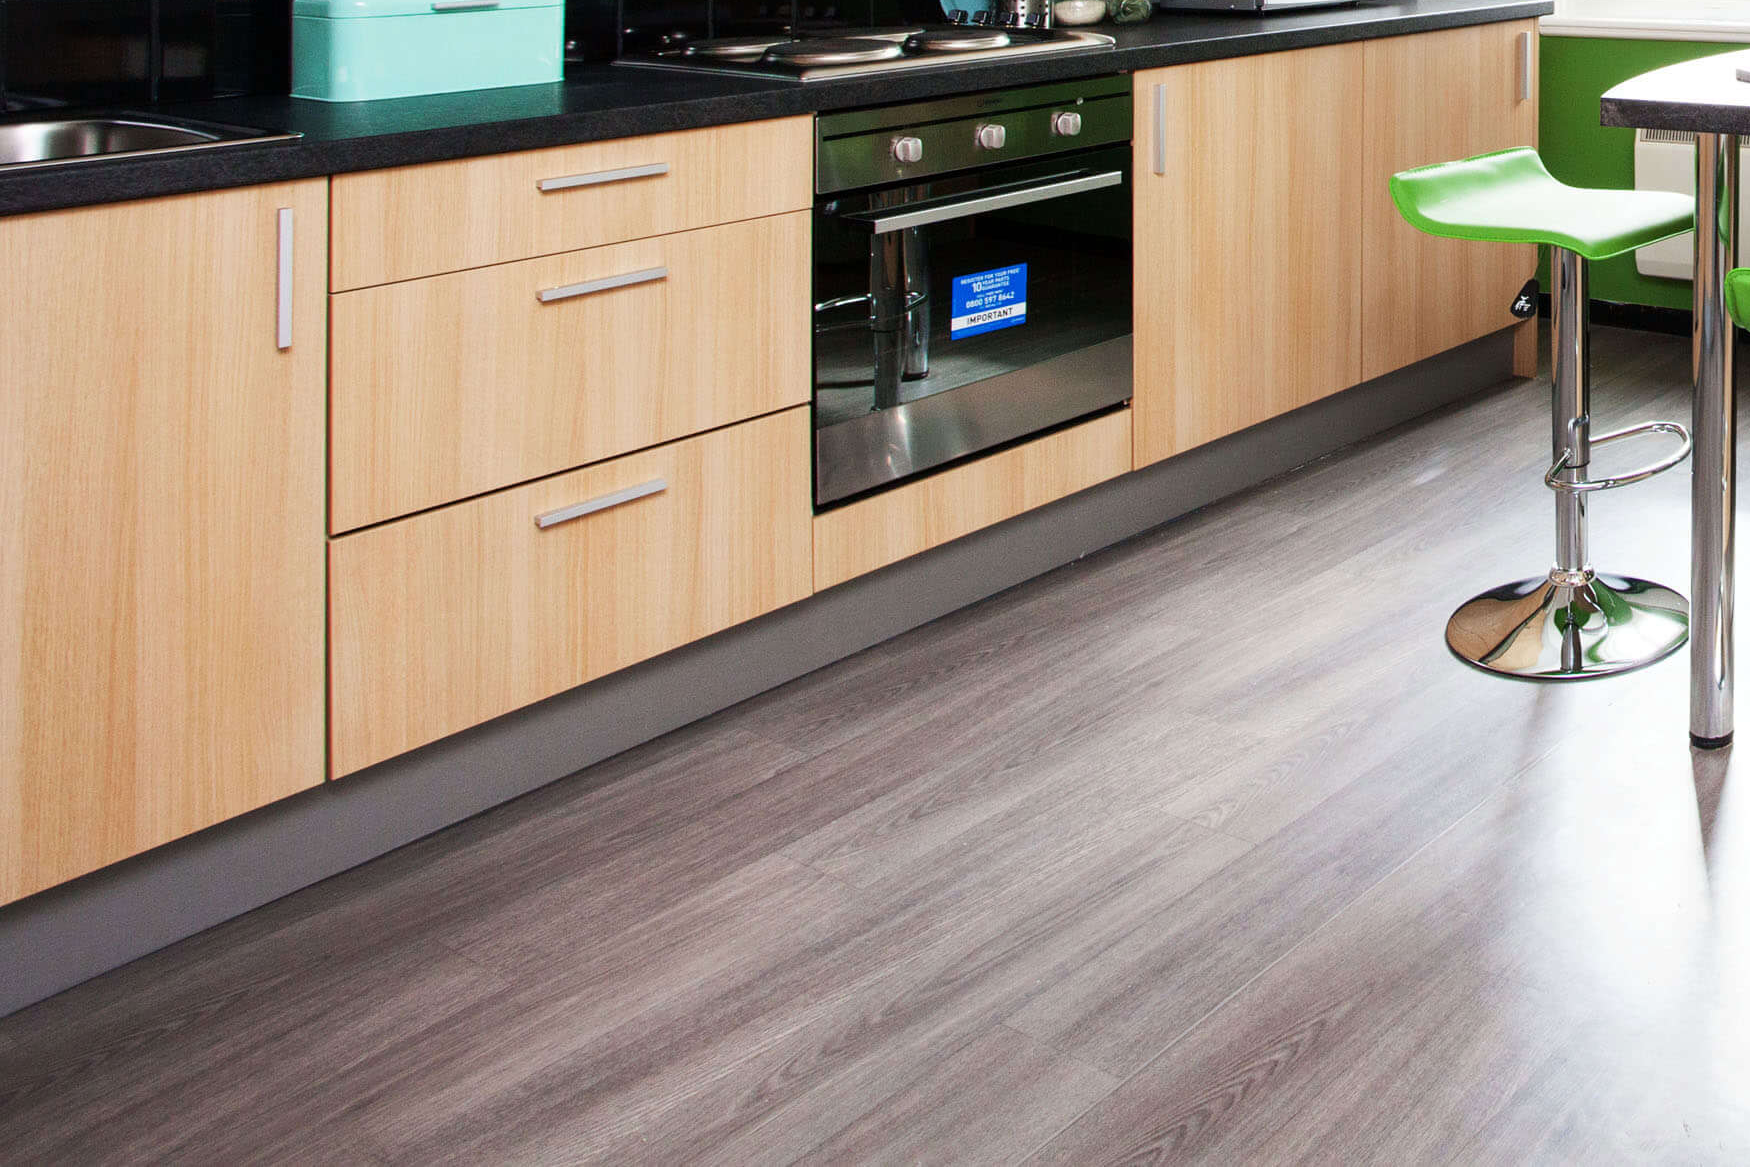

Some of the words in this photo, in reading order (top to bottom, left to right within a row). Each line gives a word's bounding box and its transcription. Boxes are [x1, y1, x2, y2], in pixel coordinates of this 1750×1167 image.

[972, 281, 982, 293] 10
[966, 298, 983, 308] 0800
[967, 307, 1013, 325] IMPORTANT
